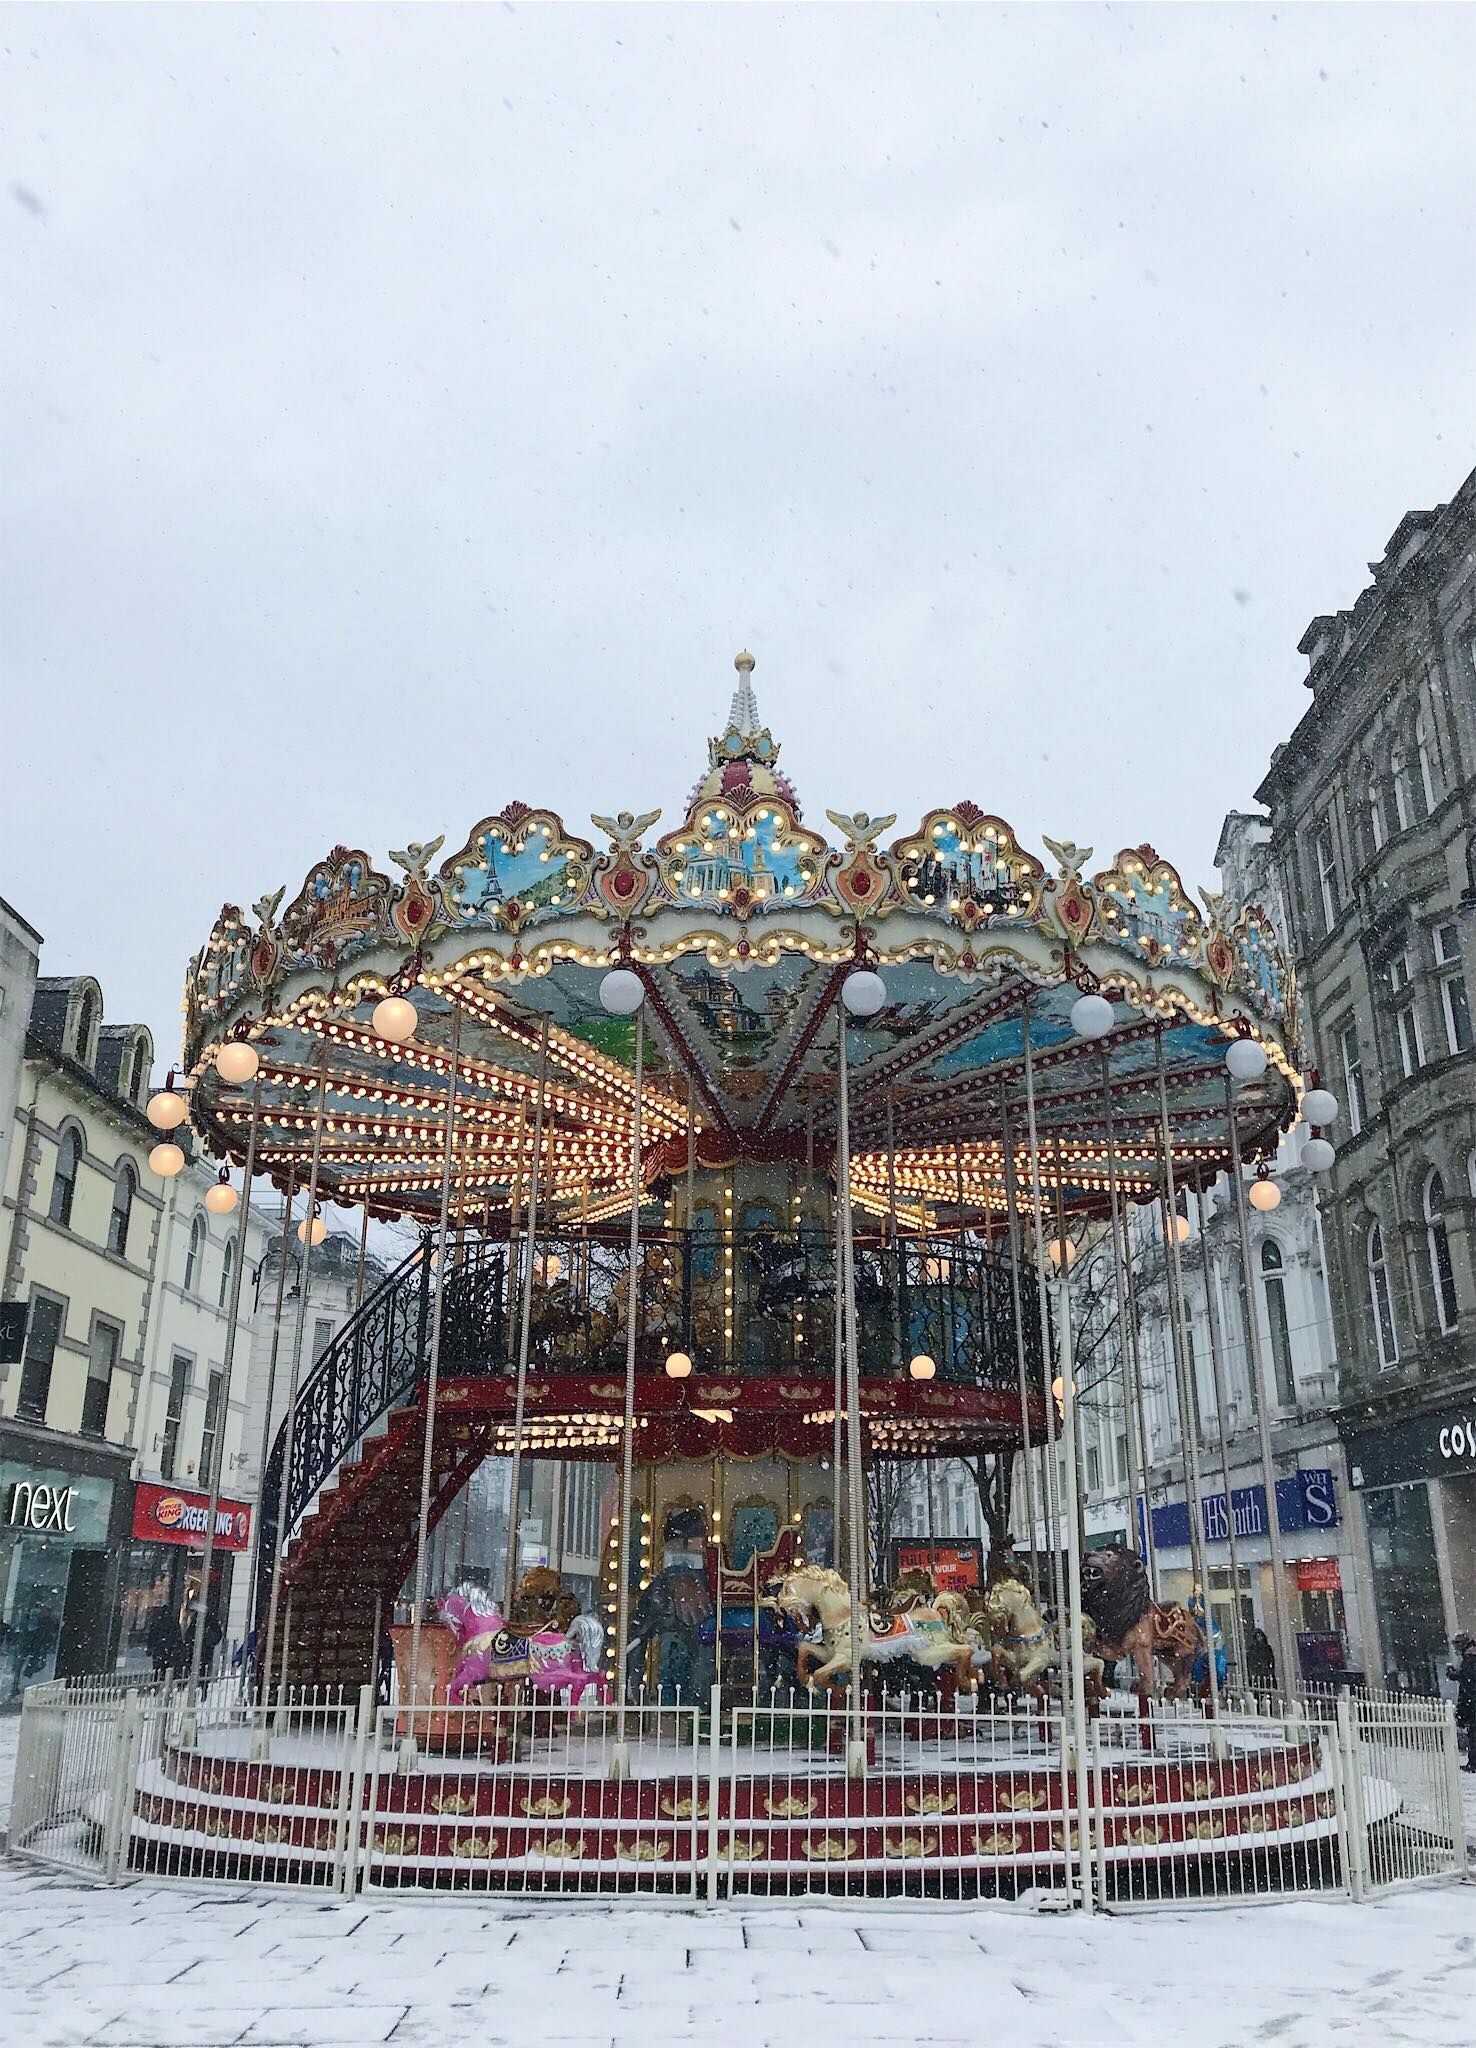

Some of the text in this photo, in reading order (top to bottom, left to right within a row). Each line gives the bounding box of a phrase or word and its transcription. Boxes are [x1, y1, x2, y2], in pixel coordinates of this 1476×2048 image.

[1440, 1421, 1476, 1458] COS
[1304, 1472, 1327, 1485] WH
[10, 1481, 80, 1532] next
[158, 1508, 182, 1519] KING
[1305, 1484, 1332, 1524] S
[215, 1511, 233, 1536] ING
